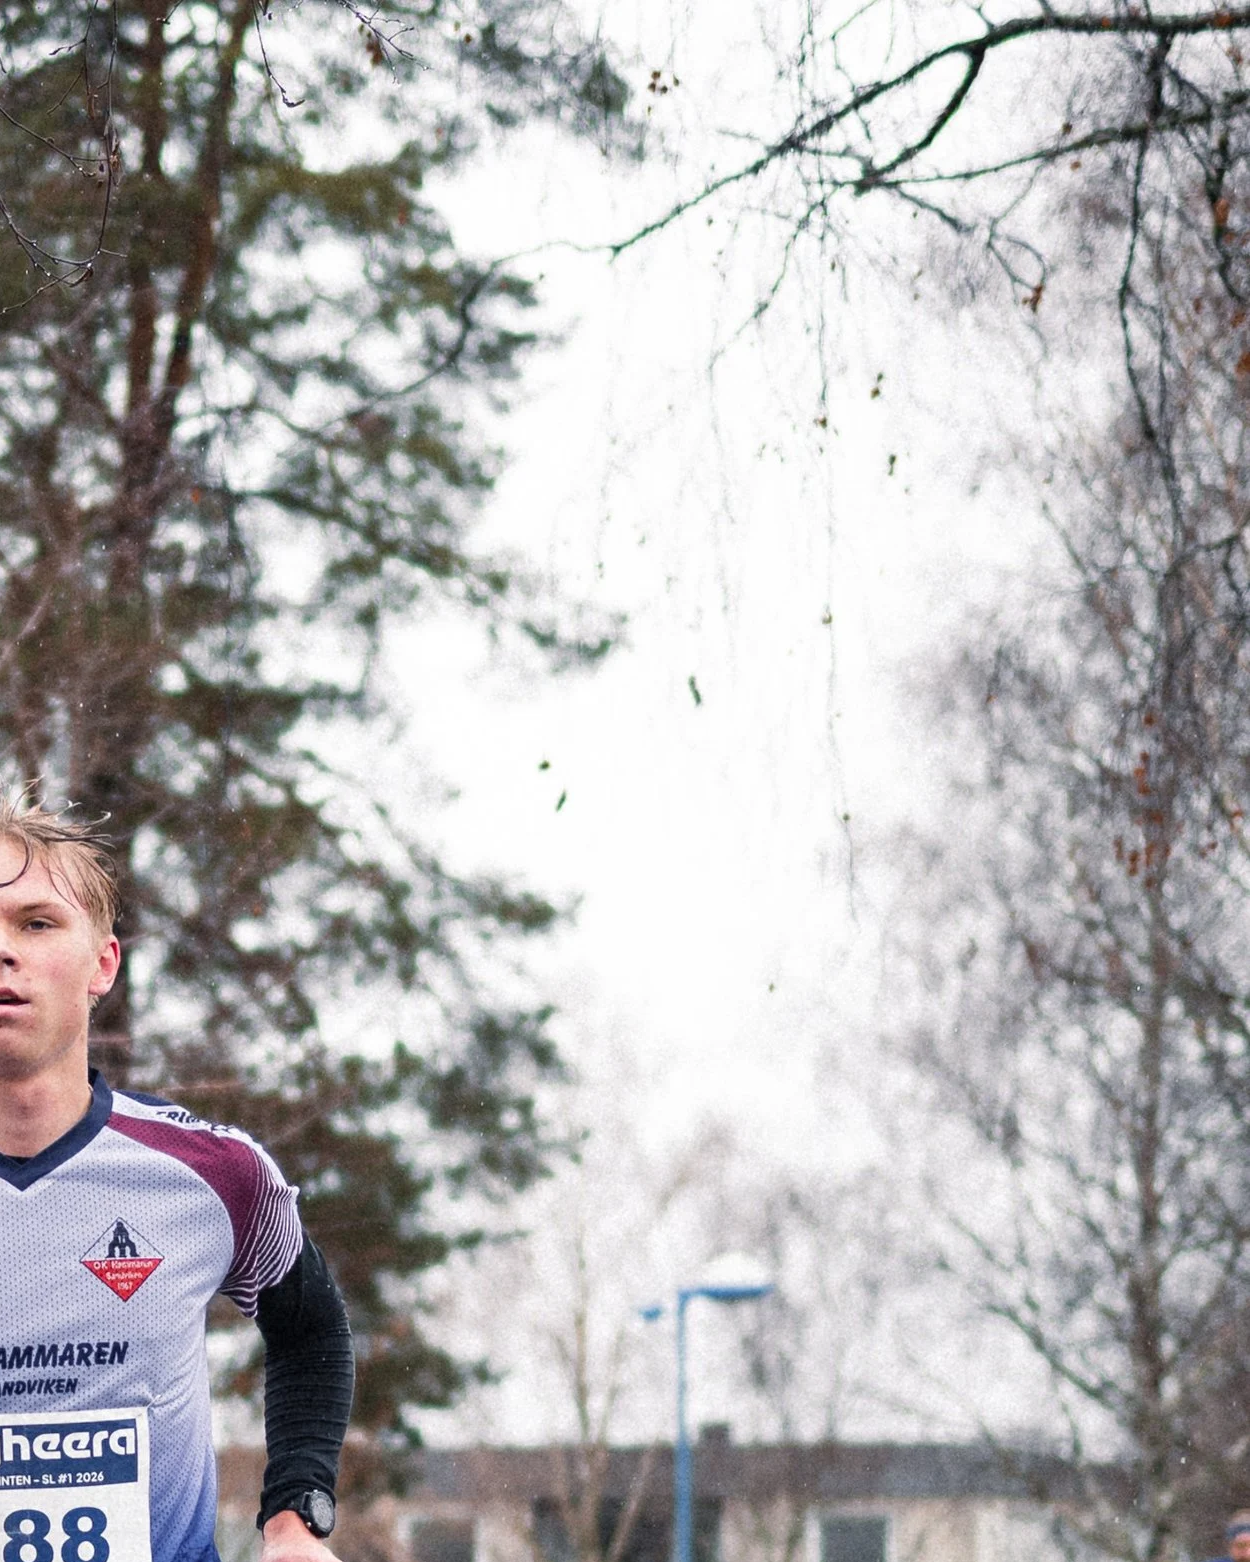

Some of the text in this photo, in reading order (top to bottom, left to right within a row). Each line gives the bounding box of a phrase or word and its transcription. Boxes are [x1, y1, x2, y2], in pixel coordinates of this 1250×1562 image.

[93, 1260, 108, 1270] OK
[41, 1473, 56, 1485] SL
[58, 1472, 73, 1484] #1
[76, 1471, 105, 1483] 2026
